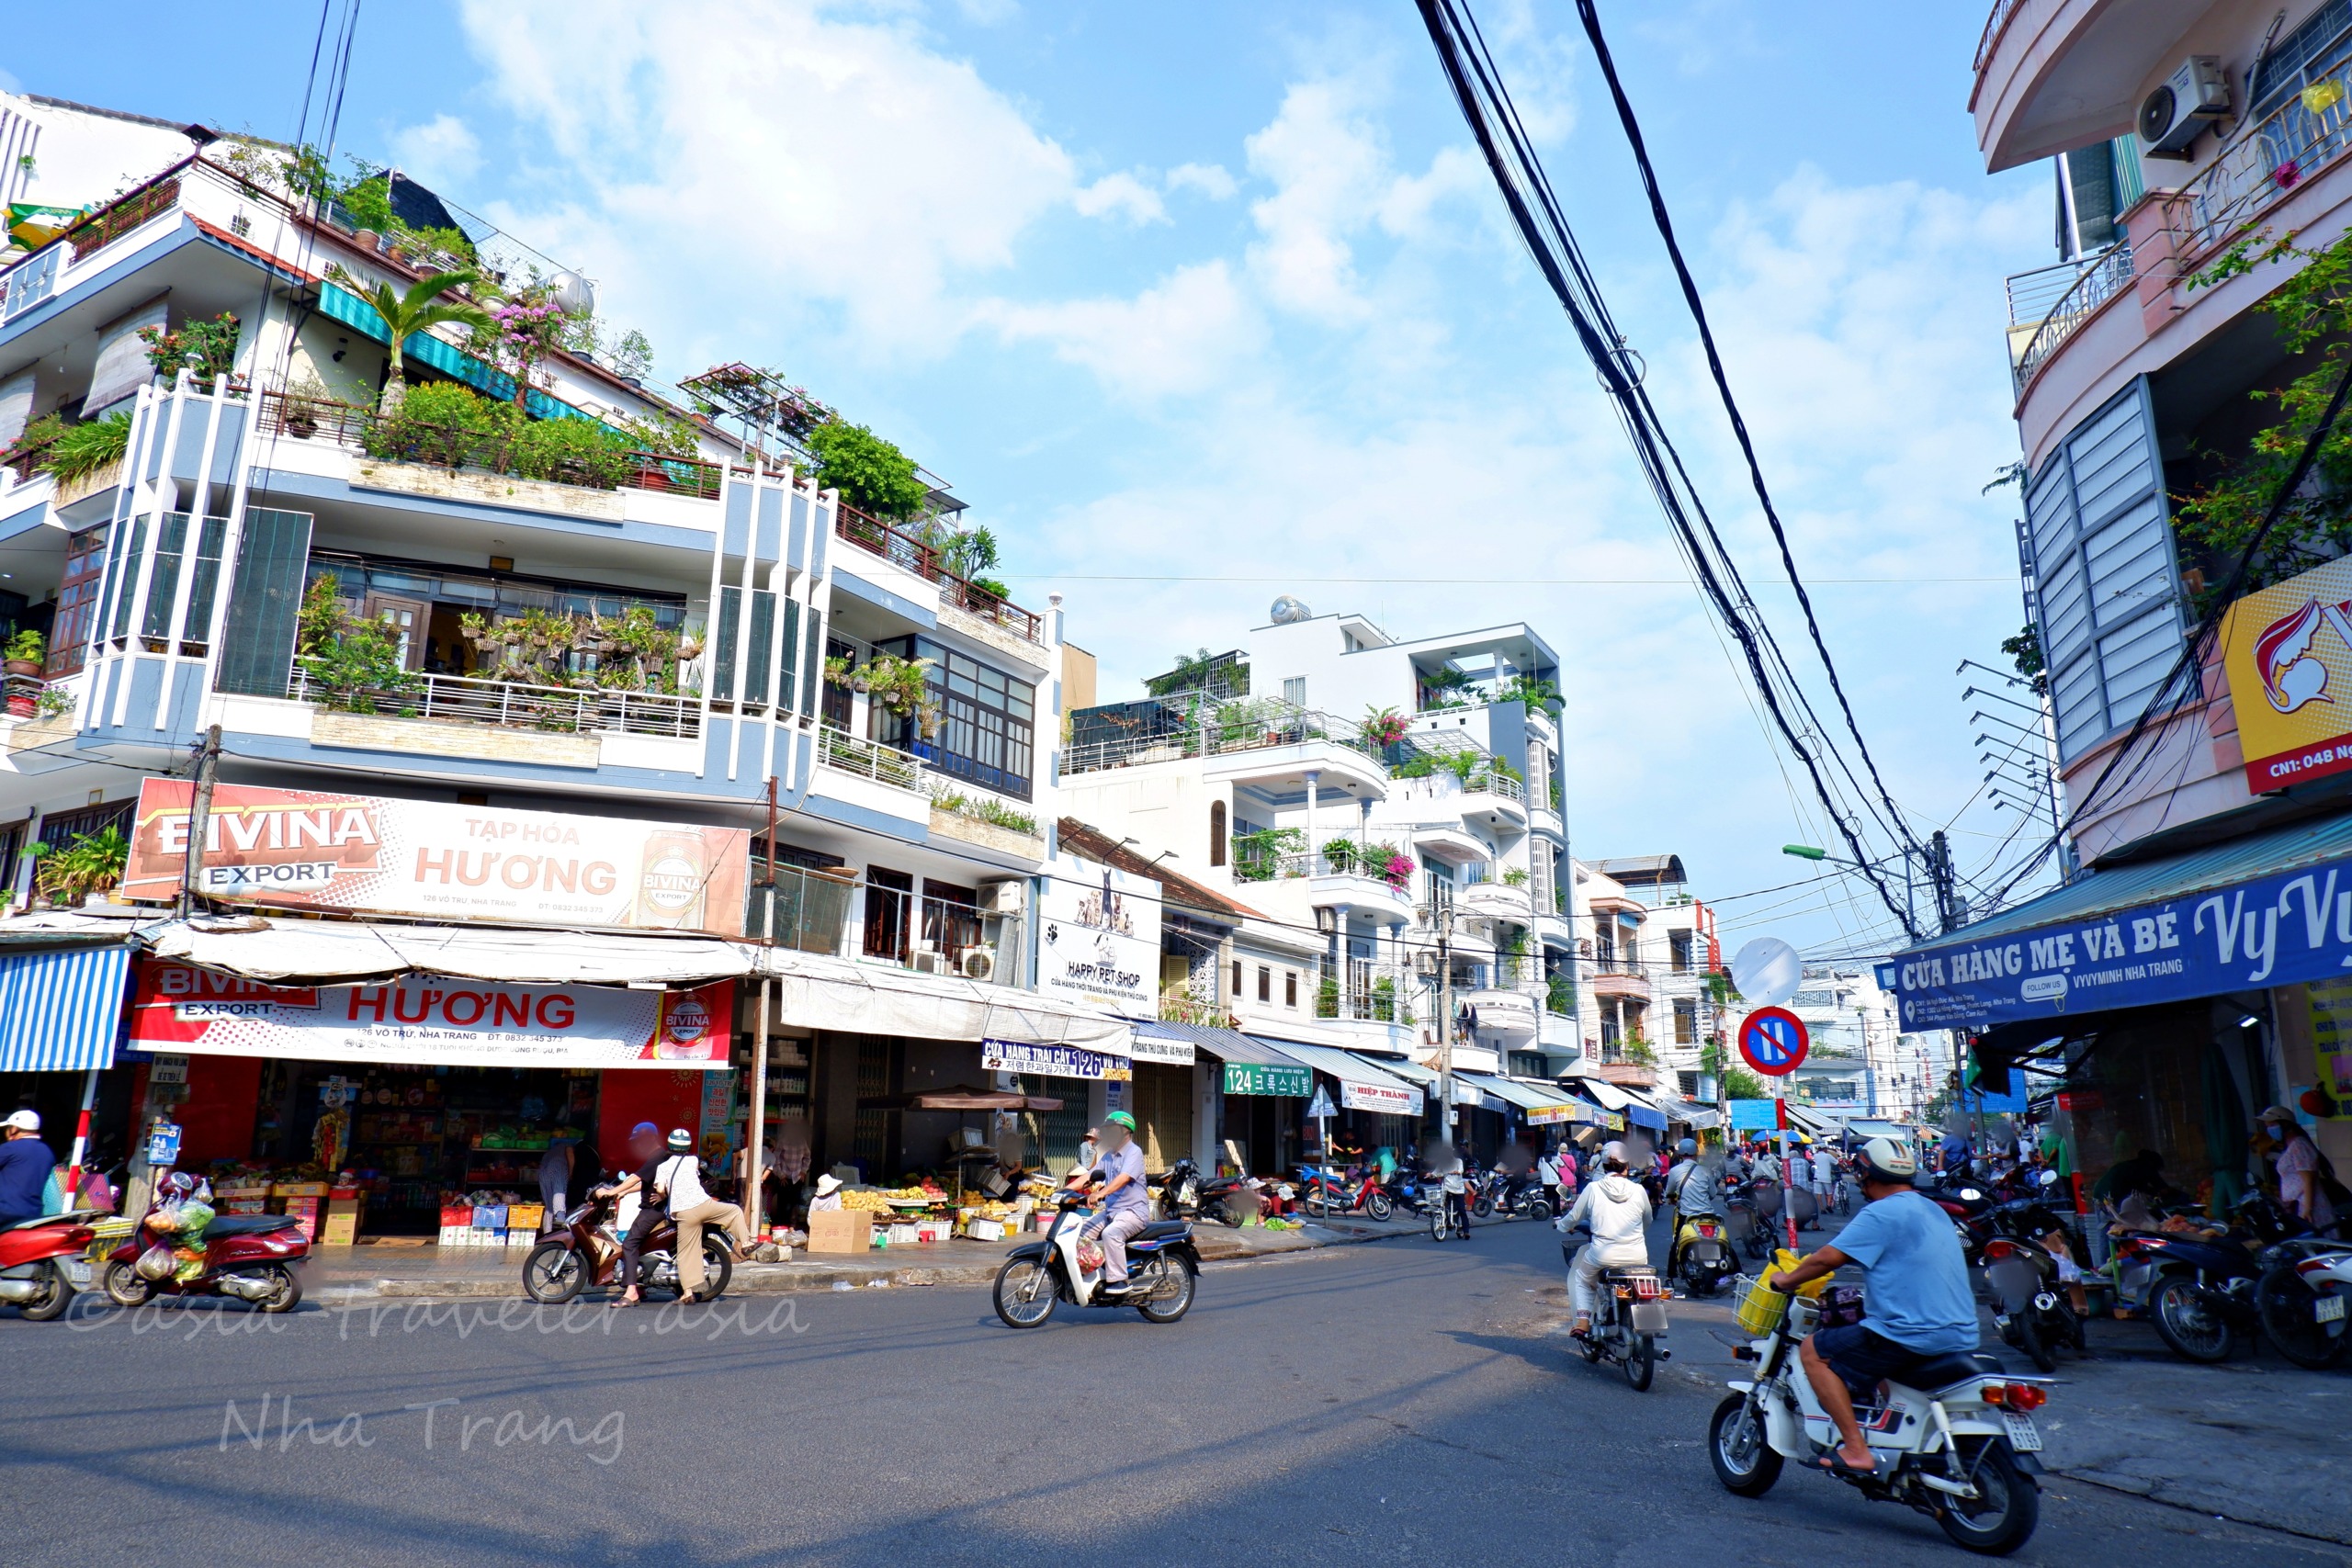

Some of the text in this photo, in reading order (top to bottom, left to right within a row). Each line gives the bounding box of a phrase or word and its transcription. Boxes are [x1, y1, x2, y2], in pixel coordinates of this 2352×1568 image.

[2269, 760, 2301, 778] CN1:
[2303, 749, 2334, 769] 04B
[465, 818, 580, 845] TẠP HÓA
[210, 863, 335, 885] EXPORT
[414, 847, 616, 896] HƯƠNG
[644, 874, 700, 892] BIVINA
[490, 899, 517, 908] TRANG
[1902, 907, 2180, 991] CỬA HÀNG MẸ VÀ BÉ
[1068, 961, 1140, 987] HAPPY PET SHOP
[2073, 958, 2183, 989] VYVYMINH NHA TRANG
[1061, 977, 1076, 989] HÀNG
[1087, 984, 1102, 993] TRANG
[2027, 981, 2061, 993] FOLLOW US
[185, 1003, 274, 1016] EXPORT
[347, 987, 576, 1030] HƯƠNG
[2003, 998, 2016, 1006] Trang
[665, 1015, 709, 1026] BIVINA
[374, 1028, 390, 1037] VÕ
[419, 1031, 441, 1040] NHA
[443, 1032, 478, 1041] TRANG
[504, 1033, 526, 1042] 0832
[985, 1039, 1070, 1065] CỬA HÀNG TRÁI CÂY
[1073, 1050, 1101, 1077] 126
[1227, 1068, 1251, 1091] 124
[1255, 1074, 1310, 1094] 크록스신발
[1357, 1086, 1410, 1100] HIỆP THÀNH
